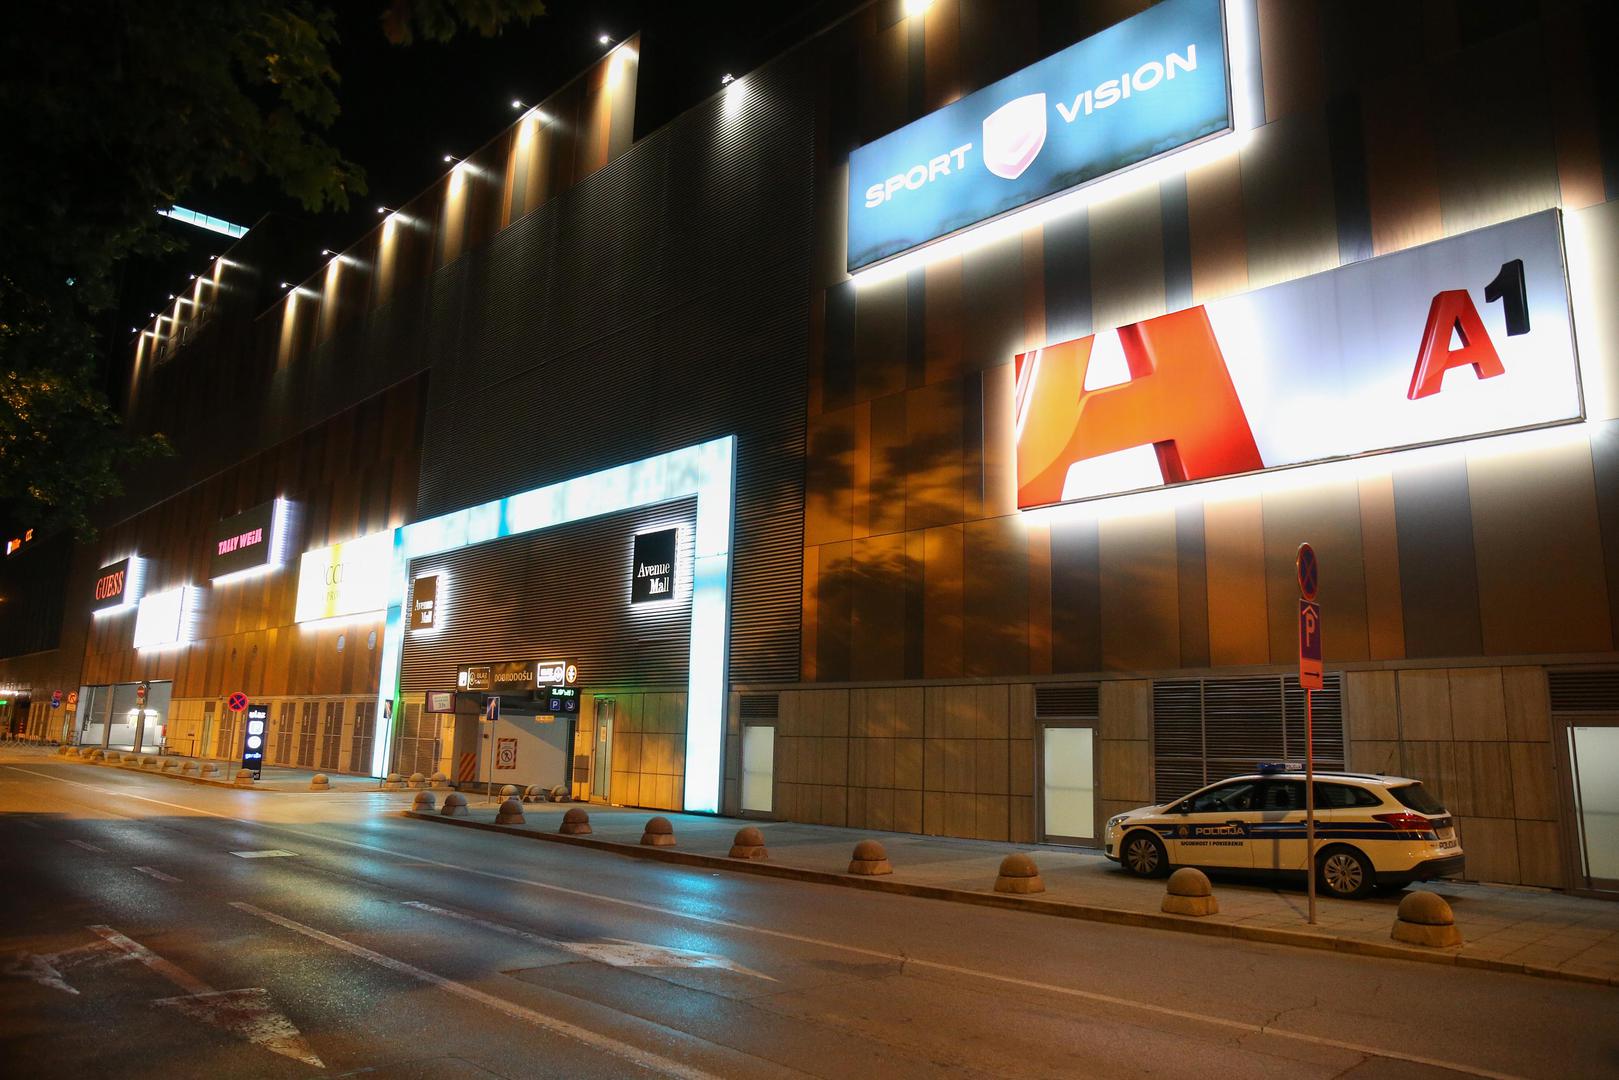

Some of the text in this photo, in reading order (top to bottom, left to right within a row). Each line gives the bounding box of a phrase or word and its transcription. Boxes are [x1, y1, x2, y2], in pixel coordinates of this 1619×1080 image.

[865, 43, 1198, 208] SPORT VISION
[218, 536, 240, 556] TALLY
[637, 562, 671, 578] Avenue
[95, 570, 124, 600] GUESS
[649, 576, 670, 595] Mall
[1195, 826, 1246, 836] POLICIJA
